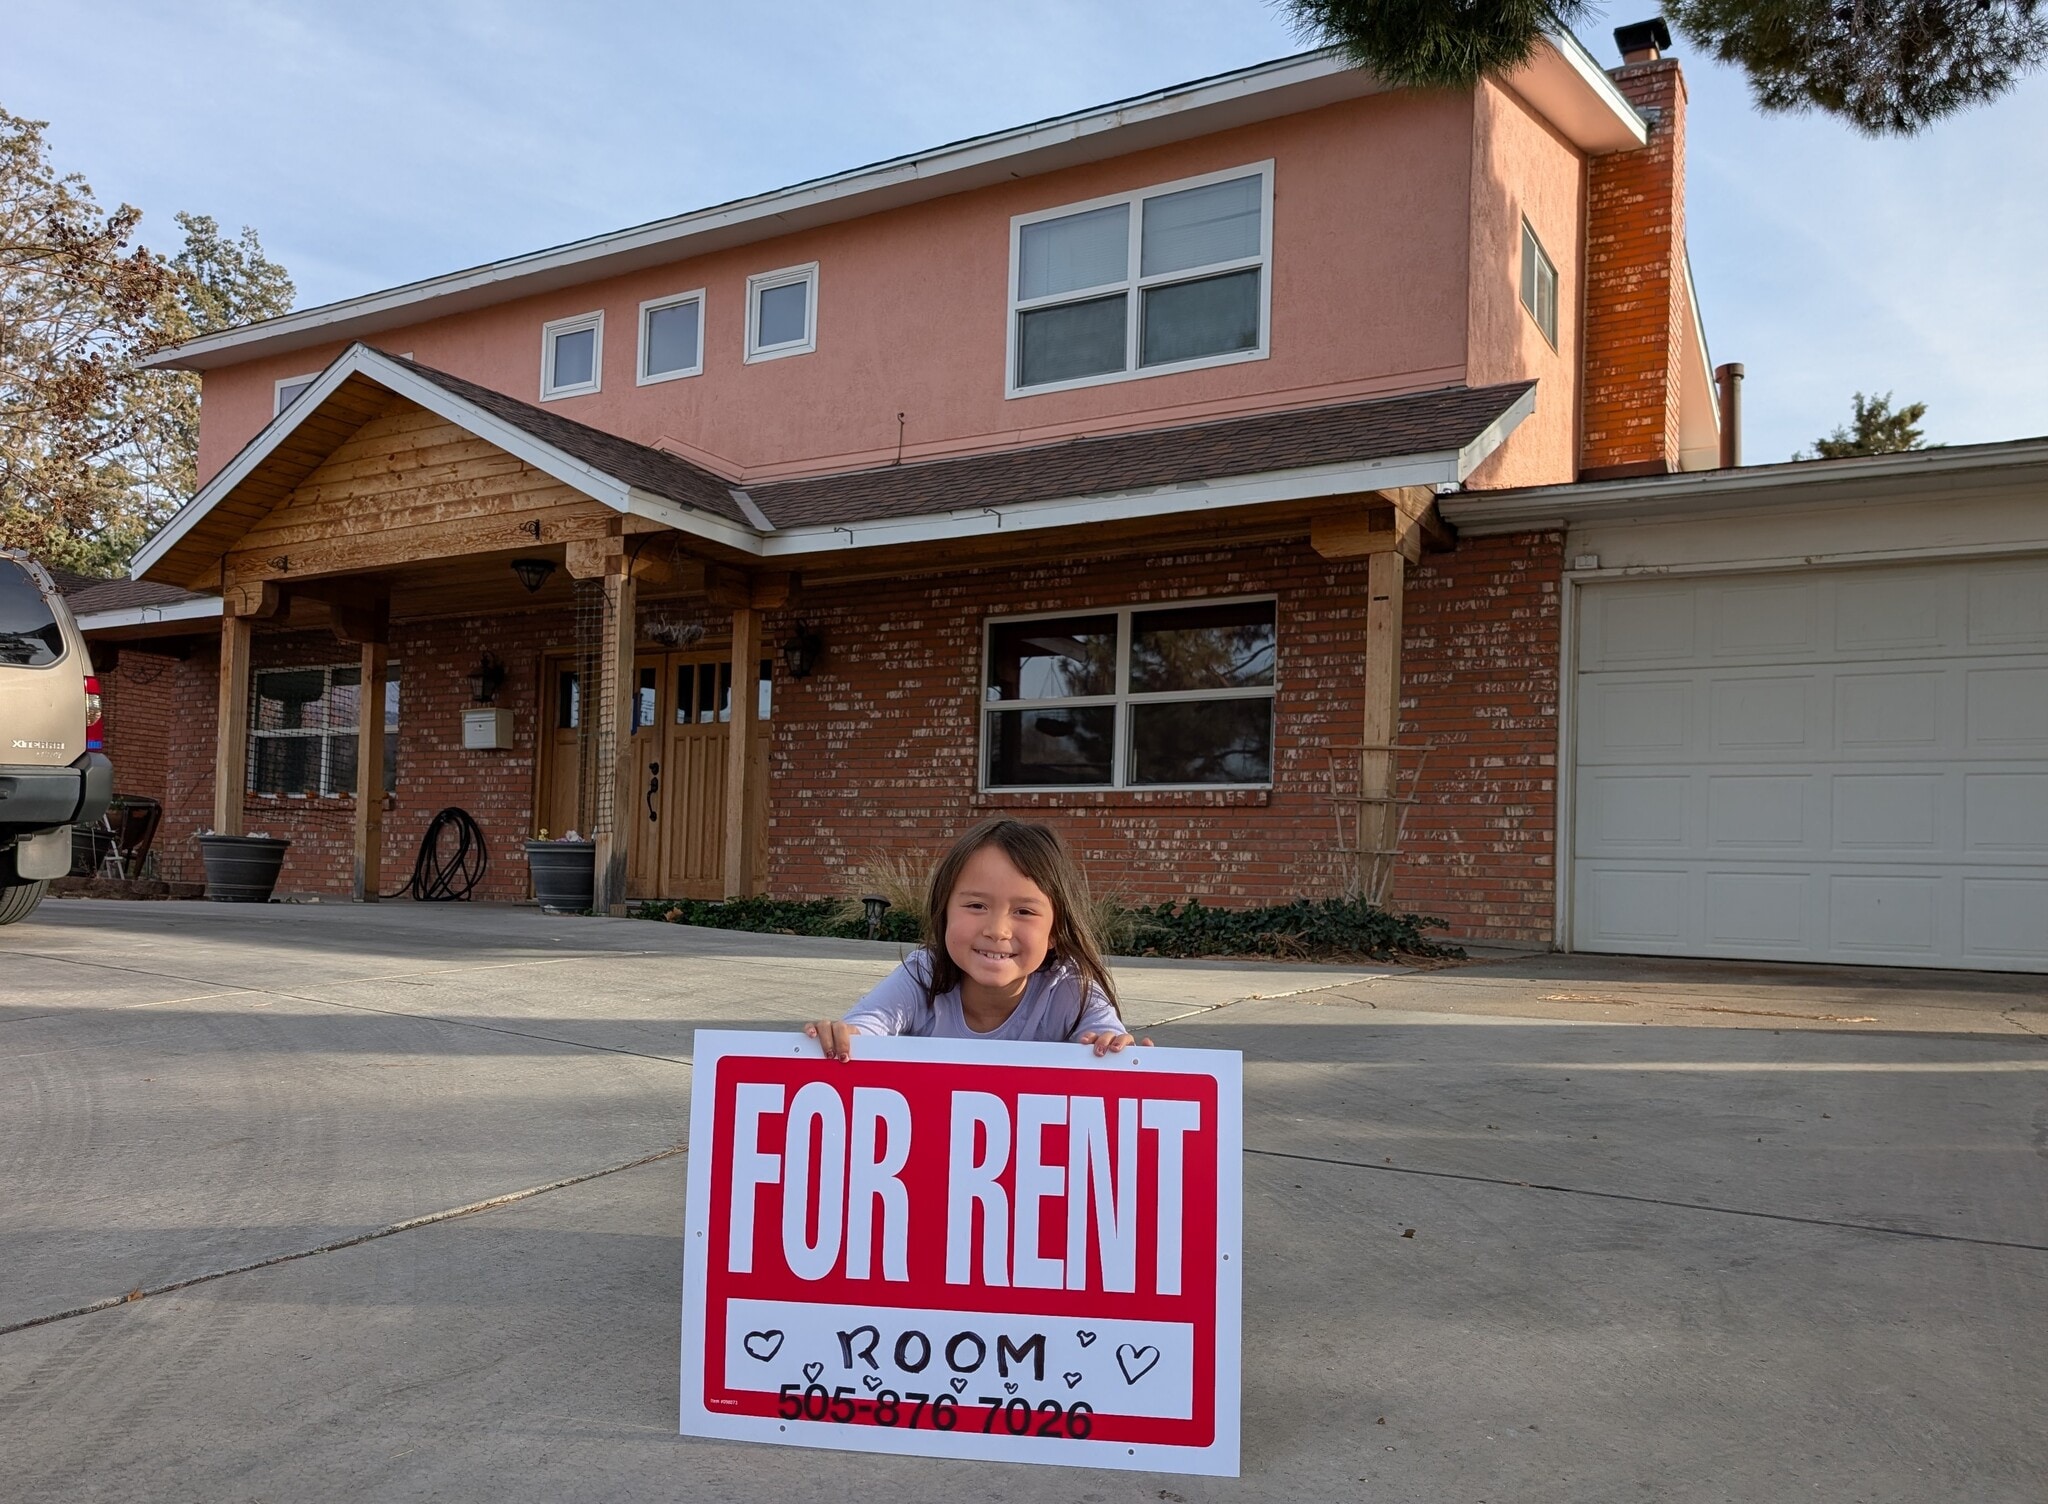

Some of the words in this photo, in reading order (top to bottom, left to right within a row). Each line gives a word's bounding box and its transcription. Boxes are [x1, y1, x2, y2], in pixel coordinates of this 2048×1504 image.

[728, 1081, 912, 1282] FOR
[945, 1090, 1201, 1296] RENT
[836, 1325, 1046, 1381] ROOM
[778, 1383, 959, 1431] 505-876
[978, 1396, 1093, 1440] 7026
